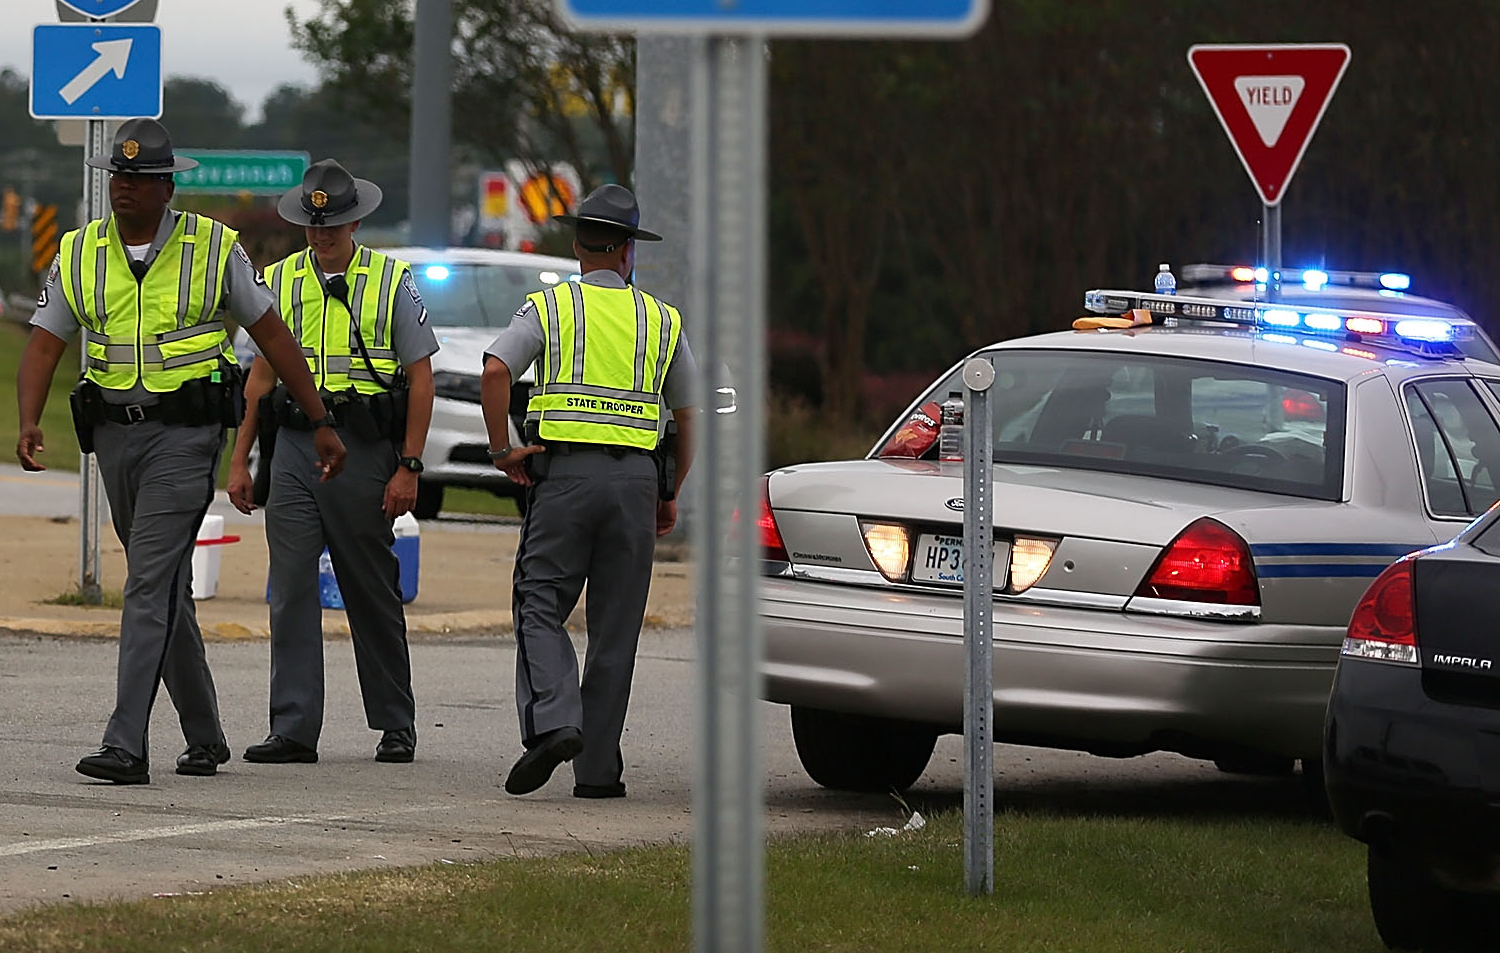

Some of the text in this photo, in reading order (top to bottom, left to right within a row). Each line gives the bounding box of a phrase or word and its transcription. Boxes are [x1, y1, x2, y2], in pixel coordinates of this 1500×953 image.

[1246, 86, 1293, 106] YIELD
[566, 397, 643, 414] STATE TROOPER
[1433, 654, 1492, 669] IMPALA
